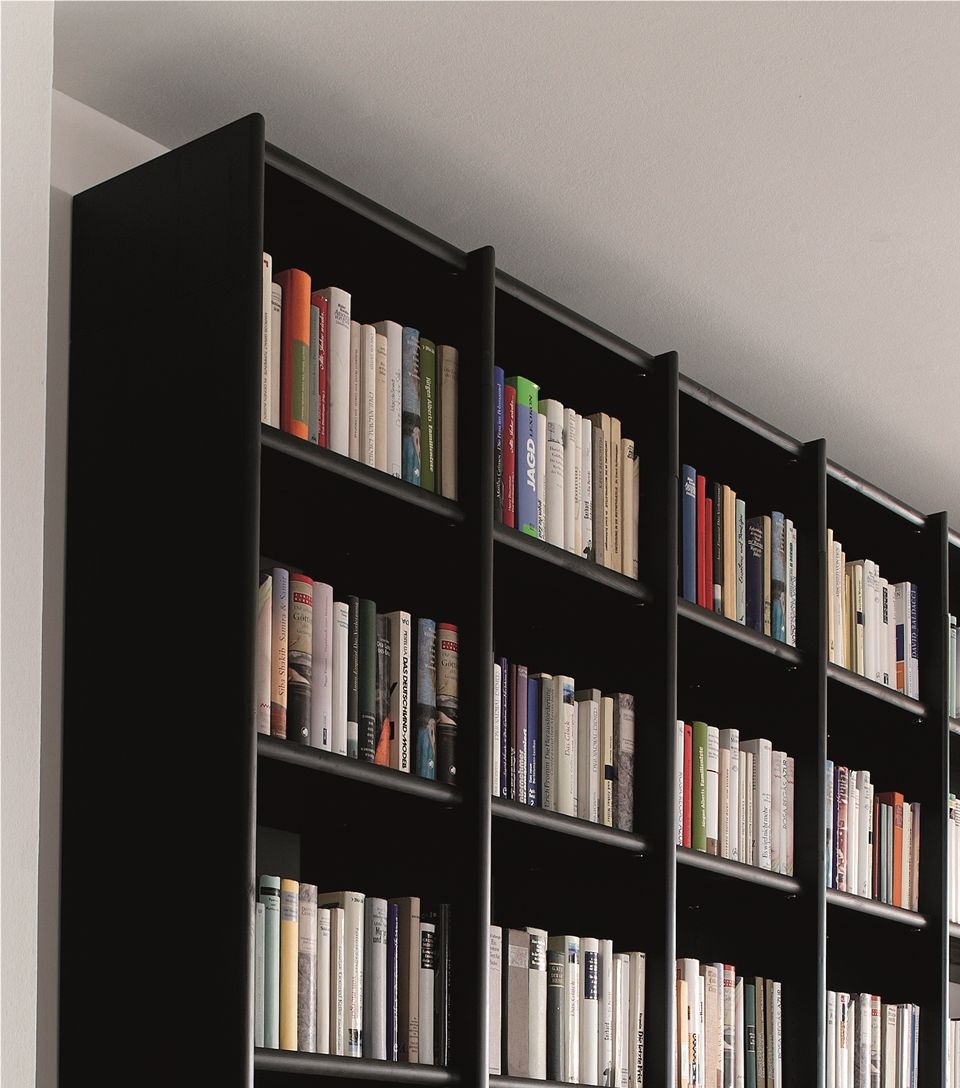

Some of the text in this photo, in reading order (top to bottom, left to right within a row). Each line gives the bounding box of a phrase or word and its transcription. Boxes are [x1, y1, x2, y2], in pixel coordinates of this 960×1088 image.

[527, 438, 536, 492] JAGD
[278, 614, 286, 642] Samira
[278, 648, 286, 676] Shakib
[278, 679, 286, 696] Siba
[544, 746, 552, 760] Die
[544, 761, 552, 787] Fromm
[544, 787, 552, 808] Erich
